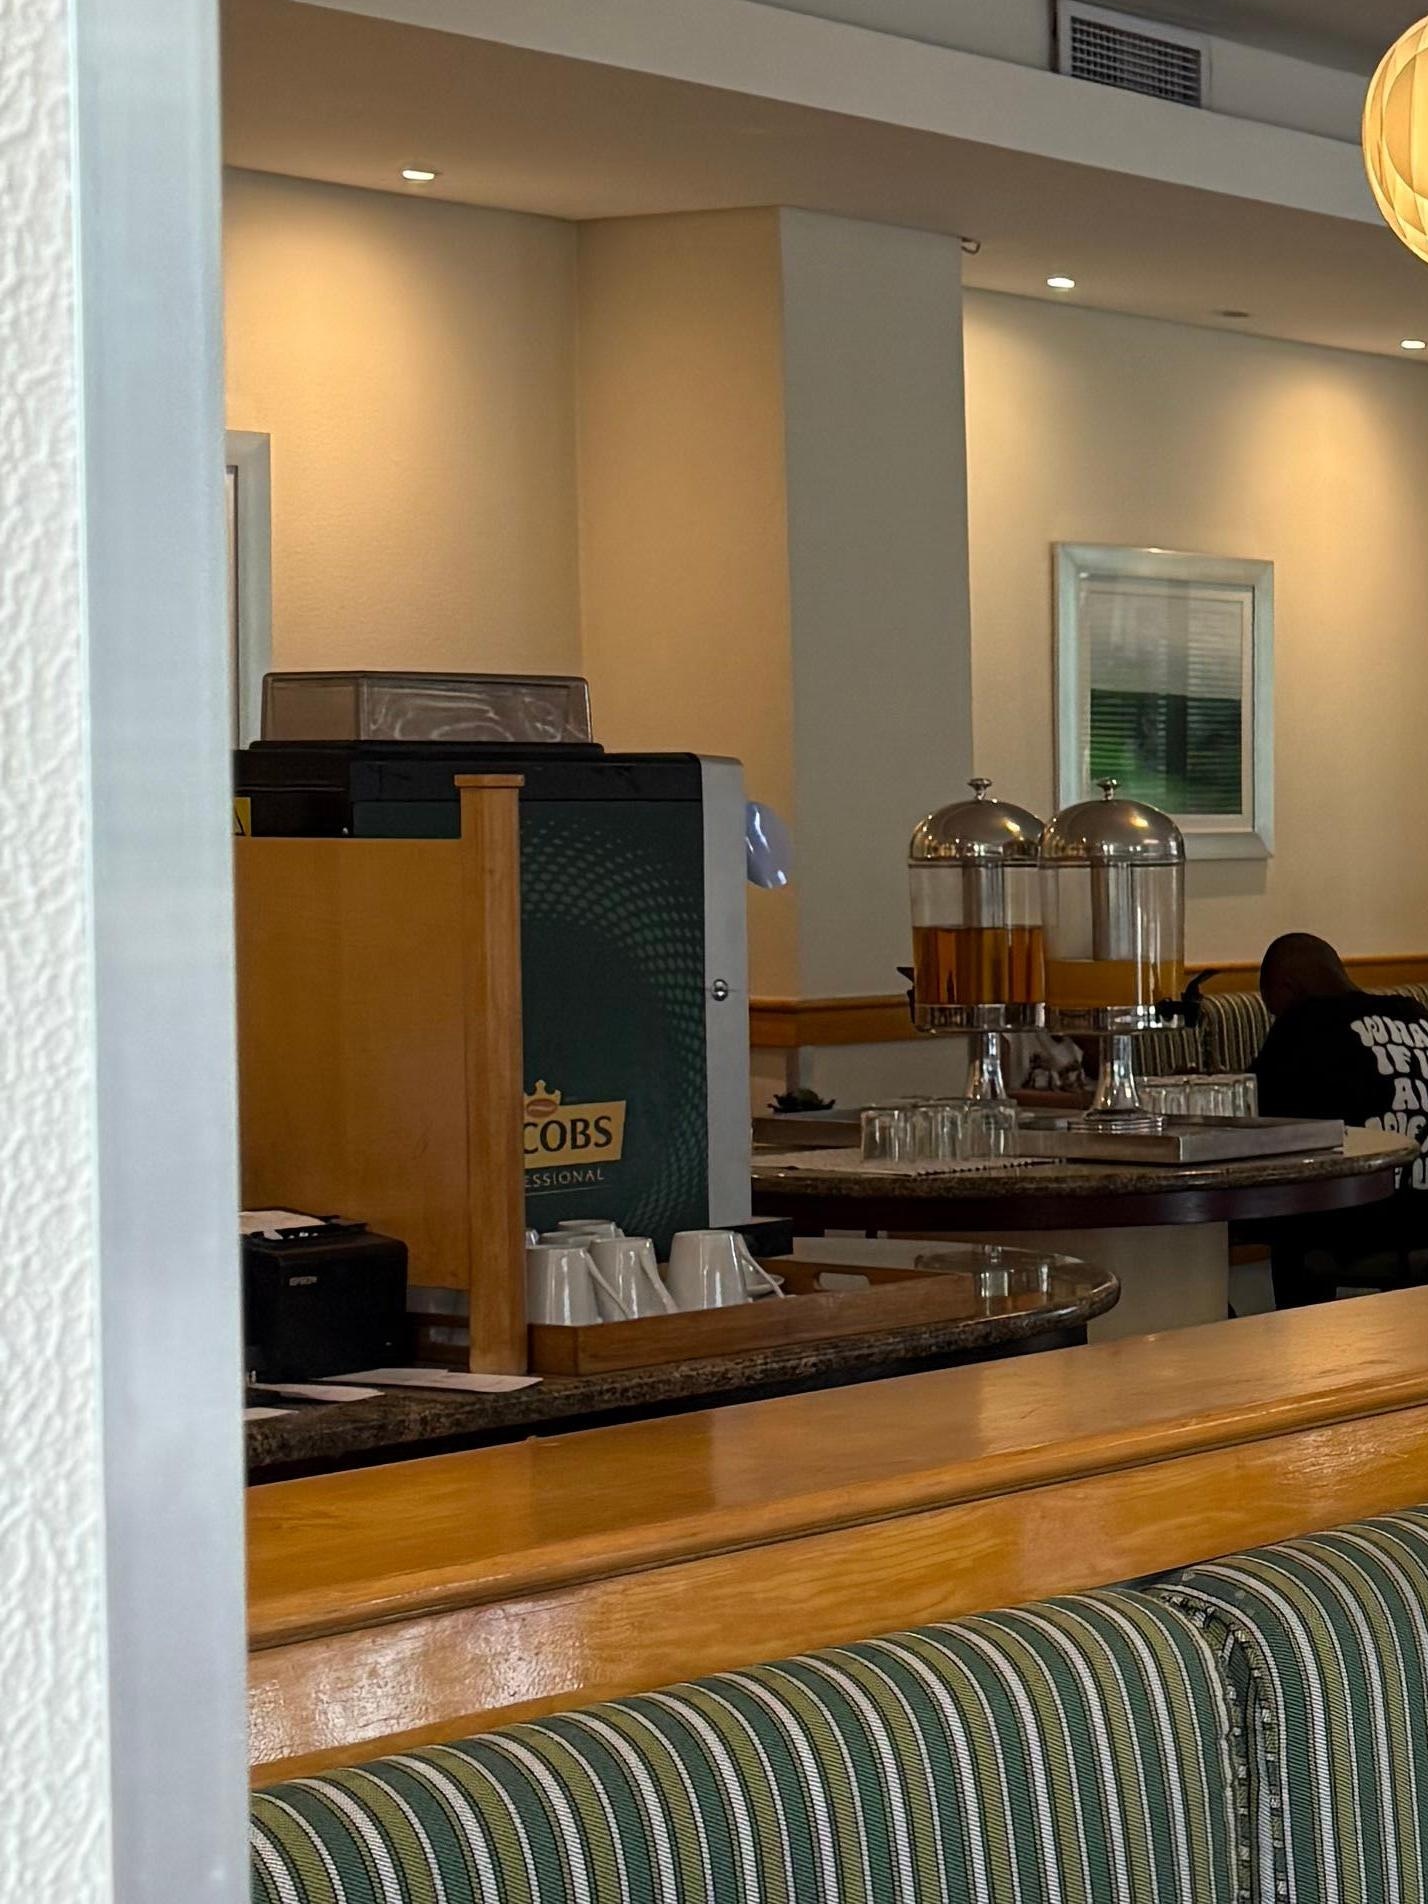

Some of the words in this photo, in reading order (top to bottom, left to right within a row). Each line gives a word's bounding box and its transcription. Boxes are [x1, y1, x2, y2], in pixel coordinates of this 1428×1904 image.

[1371, 1044, 1412, 1076] IF
[523, 1115, 613, 1154] COBS
[523, 1167, 605, 1188] ESSIONAL
